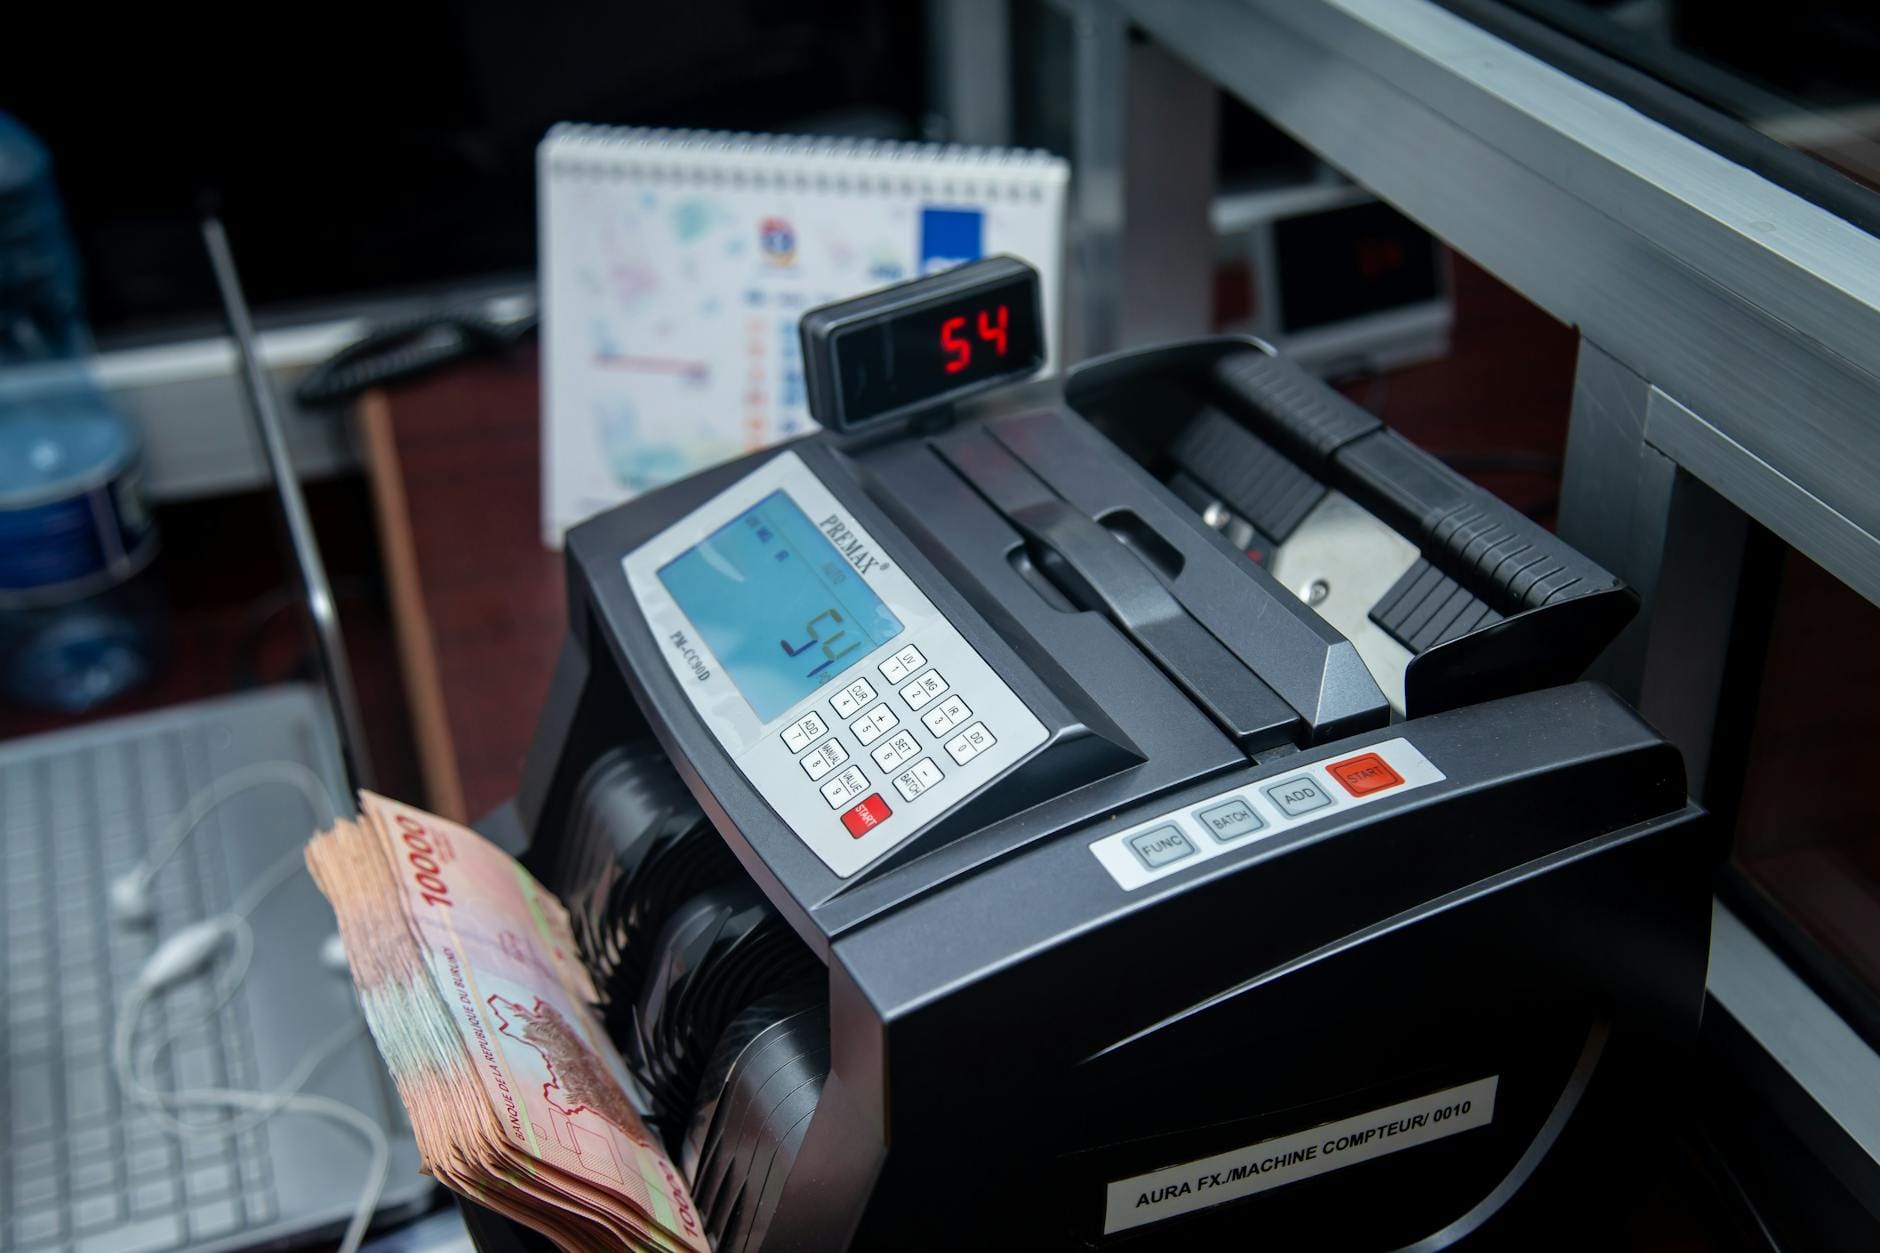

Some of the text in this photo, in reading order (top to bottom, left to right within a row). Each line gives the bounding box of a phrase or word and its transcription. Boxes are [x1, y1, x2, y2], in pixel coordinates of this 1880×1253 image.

[940, 304, 1009, 375] 54
[819, 514, 879, 575] PREMAX
[780, 608, 861, 678] 54
[902, 653, 916, 665] UV
[924, 677, 939, 692] MG
[852, 685, 868, 702] CUR
[912, 690, 921, 698] 2
[947, 705, 960, 717] IR
[803, 719, 819, 736] ADD
[862, 725, 872, 734] 5
[934, 717, 944, 725] 3
[895, 737, 912, 754] SET
[970, 731, 984, 744] DD
[822, 743, 841, 766] MANUAL
[883, 752, 893, 760] 6
[812, 760, 821, 768] 8
[843, 770, 863, 794] VALUE
[1346, 766, 1383, 785] START
[832, 787, 842, 796] 9
[899, 773, 920, 796] BATCH
[1283, 787, 1316, 805] ADD
[855, 804, 877, 828] START
[1212, 807, 1250, 830] BATCH
[1141, 835, 1183, 858] FUNC
[395, 815, 453, 907] 10000
[489, 1064, 502, 1077] LA
[495, 1077, 509, 1092] DE
[502, 1092, 525, 1141] BANQUE
[1136, 1101, 1472, 1208] AURA FX./MACHINE COMPTEUR/ 0010
